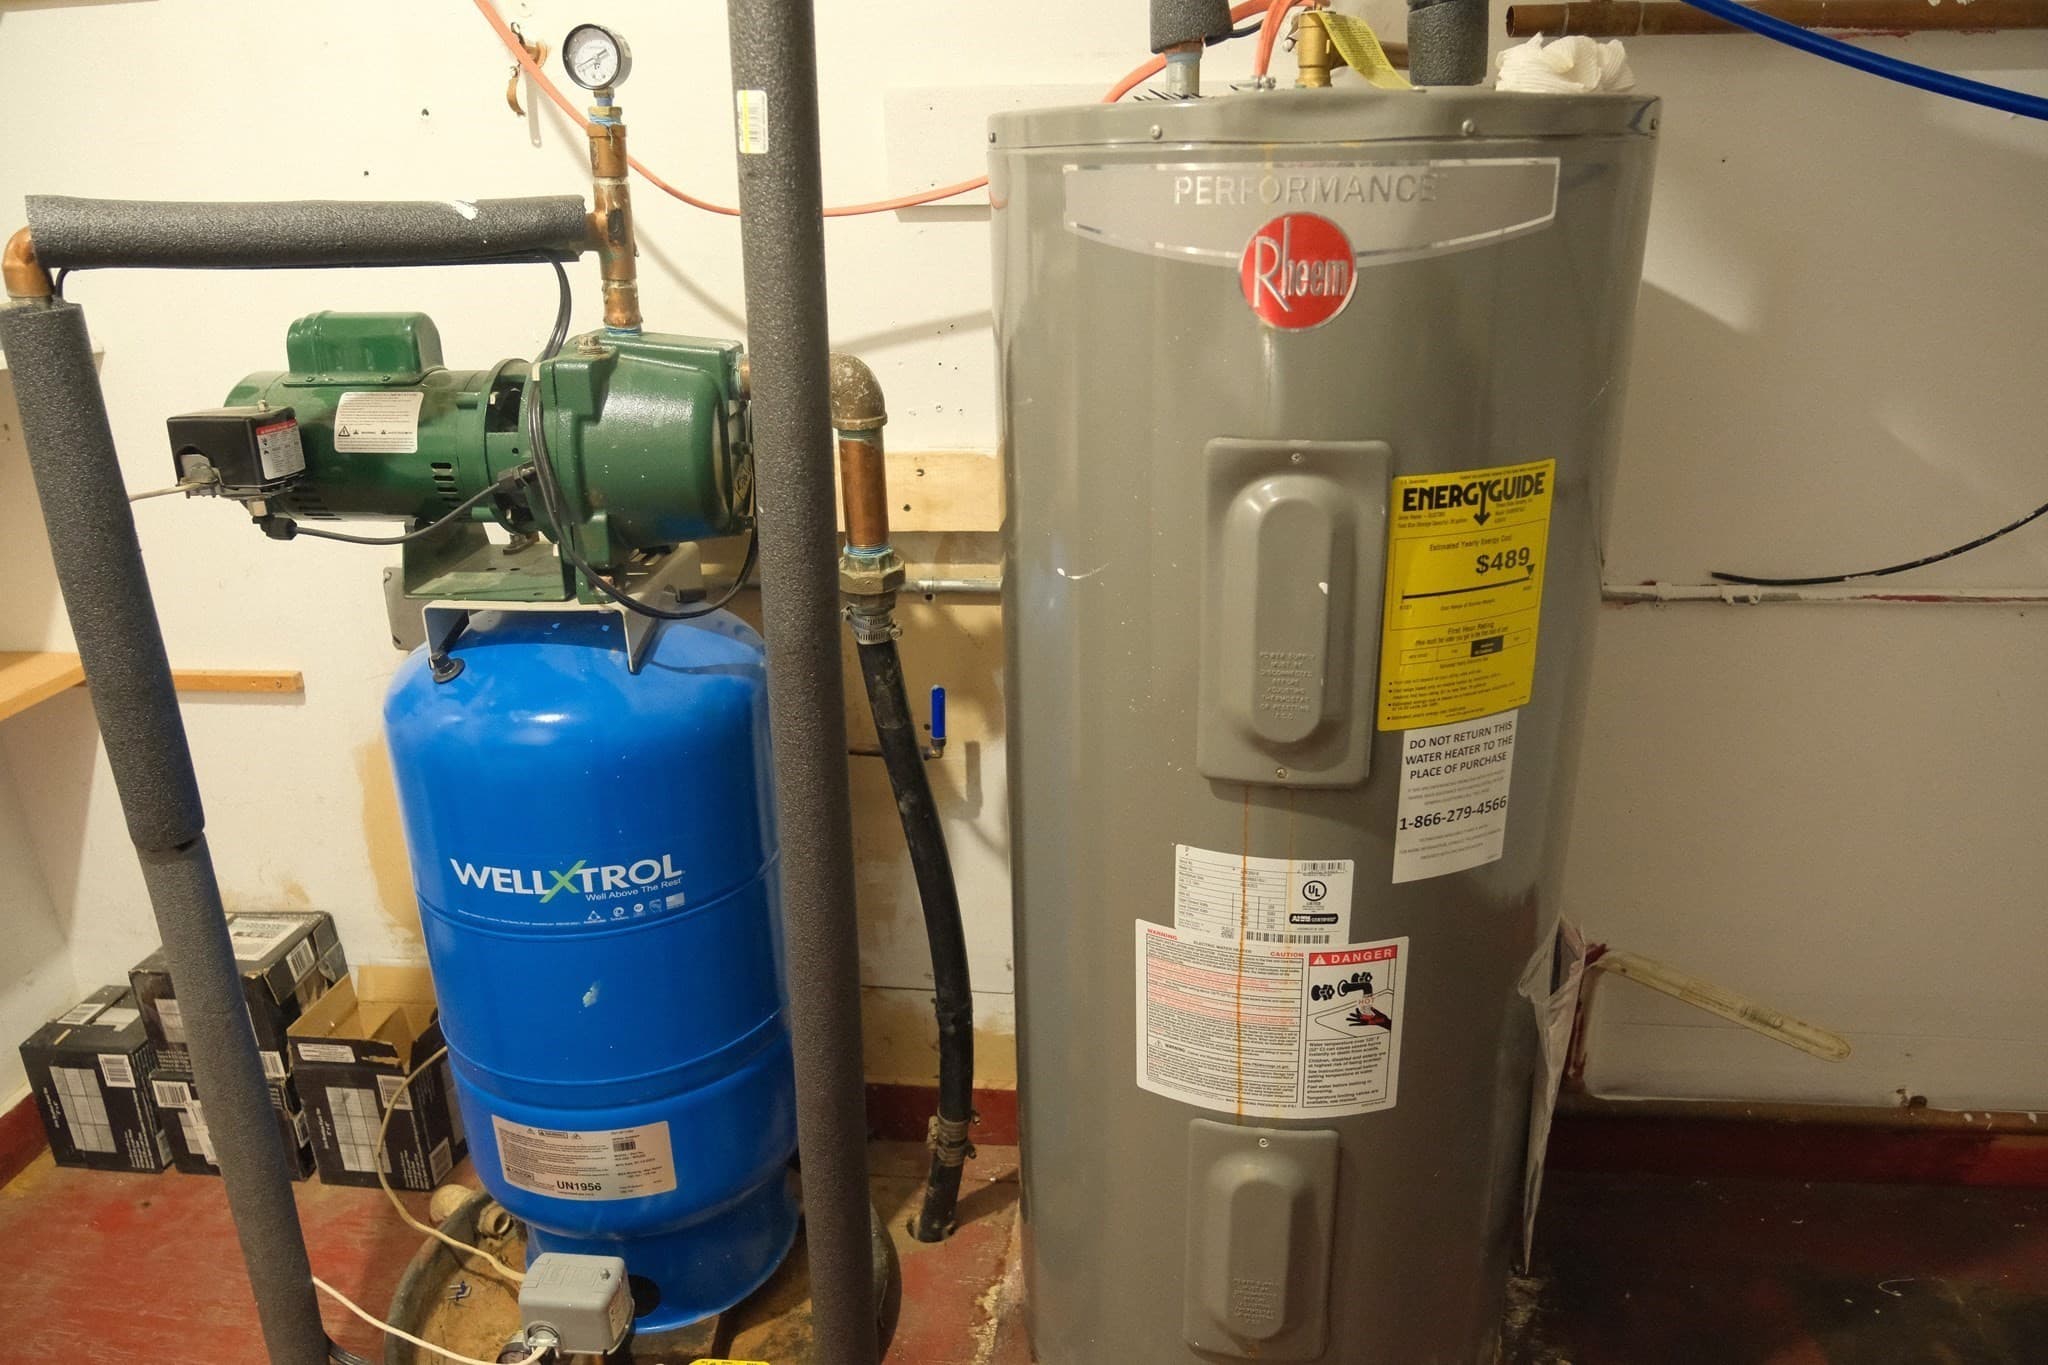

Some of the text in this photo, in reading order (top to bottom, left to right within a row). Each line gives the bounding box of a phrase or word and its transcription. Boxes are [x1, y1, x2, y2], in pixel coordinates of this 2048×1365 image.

[1174, 172, 1438, 206] PERFORMANCE
[1252, 215, 1350, 312] Rheem
[1403, 472, 1546, 512] ENERGYGUIDE
[1475, 547, 1530, 574] $489
[1410, 721, 1513, 749] DO NOT RETURN THIS
[1405, 735, 1513, 765] WATER HEATER TO THE
[1409, 752, 1507, 779] PLACE OF PURCHASE
[1399, 795, 1507, 830] 1-866-279-4566
[586, 878, 682, 902] Well Above The Rest
[1308, 885, 1320, 897] UL
[1331, 948, 1392, 964] DANGER
[1358, 997, 1375, 1006] HOT
[557, 1180, 602, 1191] UN1956
